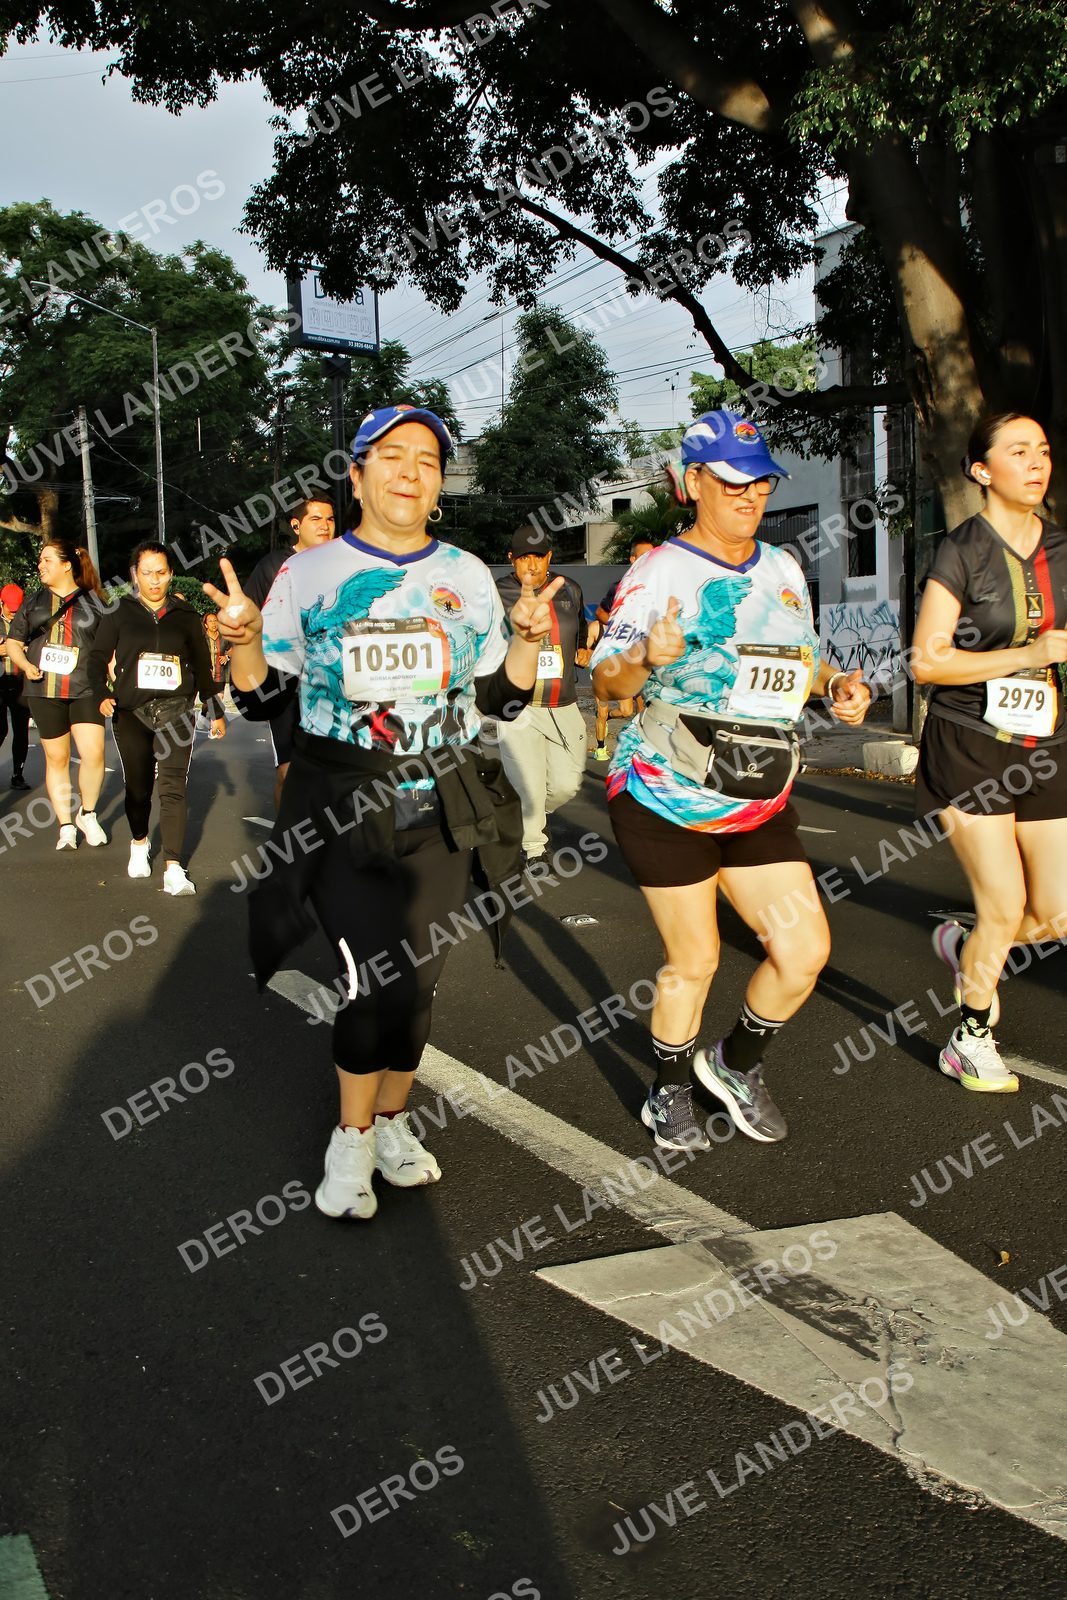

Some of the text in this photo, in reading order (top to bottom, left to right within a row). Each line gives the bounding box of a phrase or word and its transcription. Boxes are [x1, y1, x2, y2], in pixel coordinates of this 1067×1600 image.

[45, 652, 70, 664] 6599
[349, 643, 432, 672] 10501
[144, 665, 173, 677] 2780
[750, 666, 796, 692] 1183
[998, 686, 1045, 711] 2979
